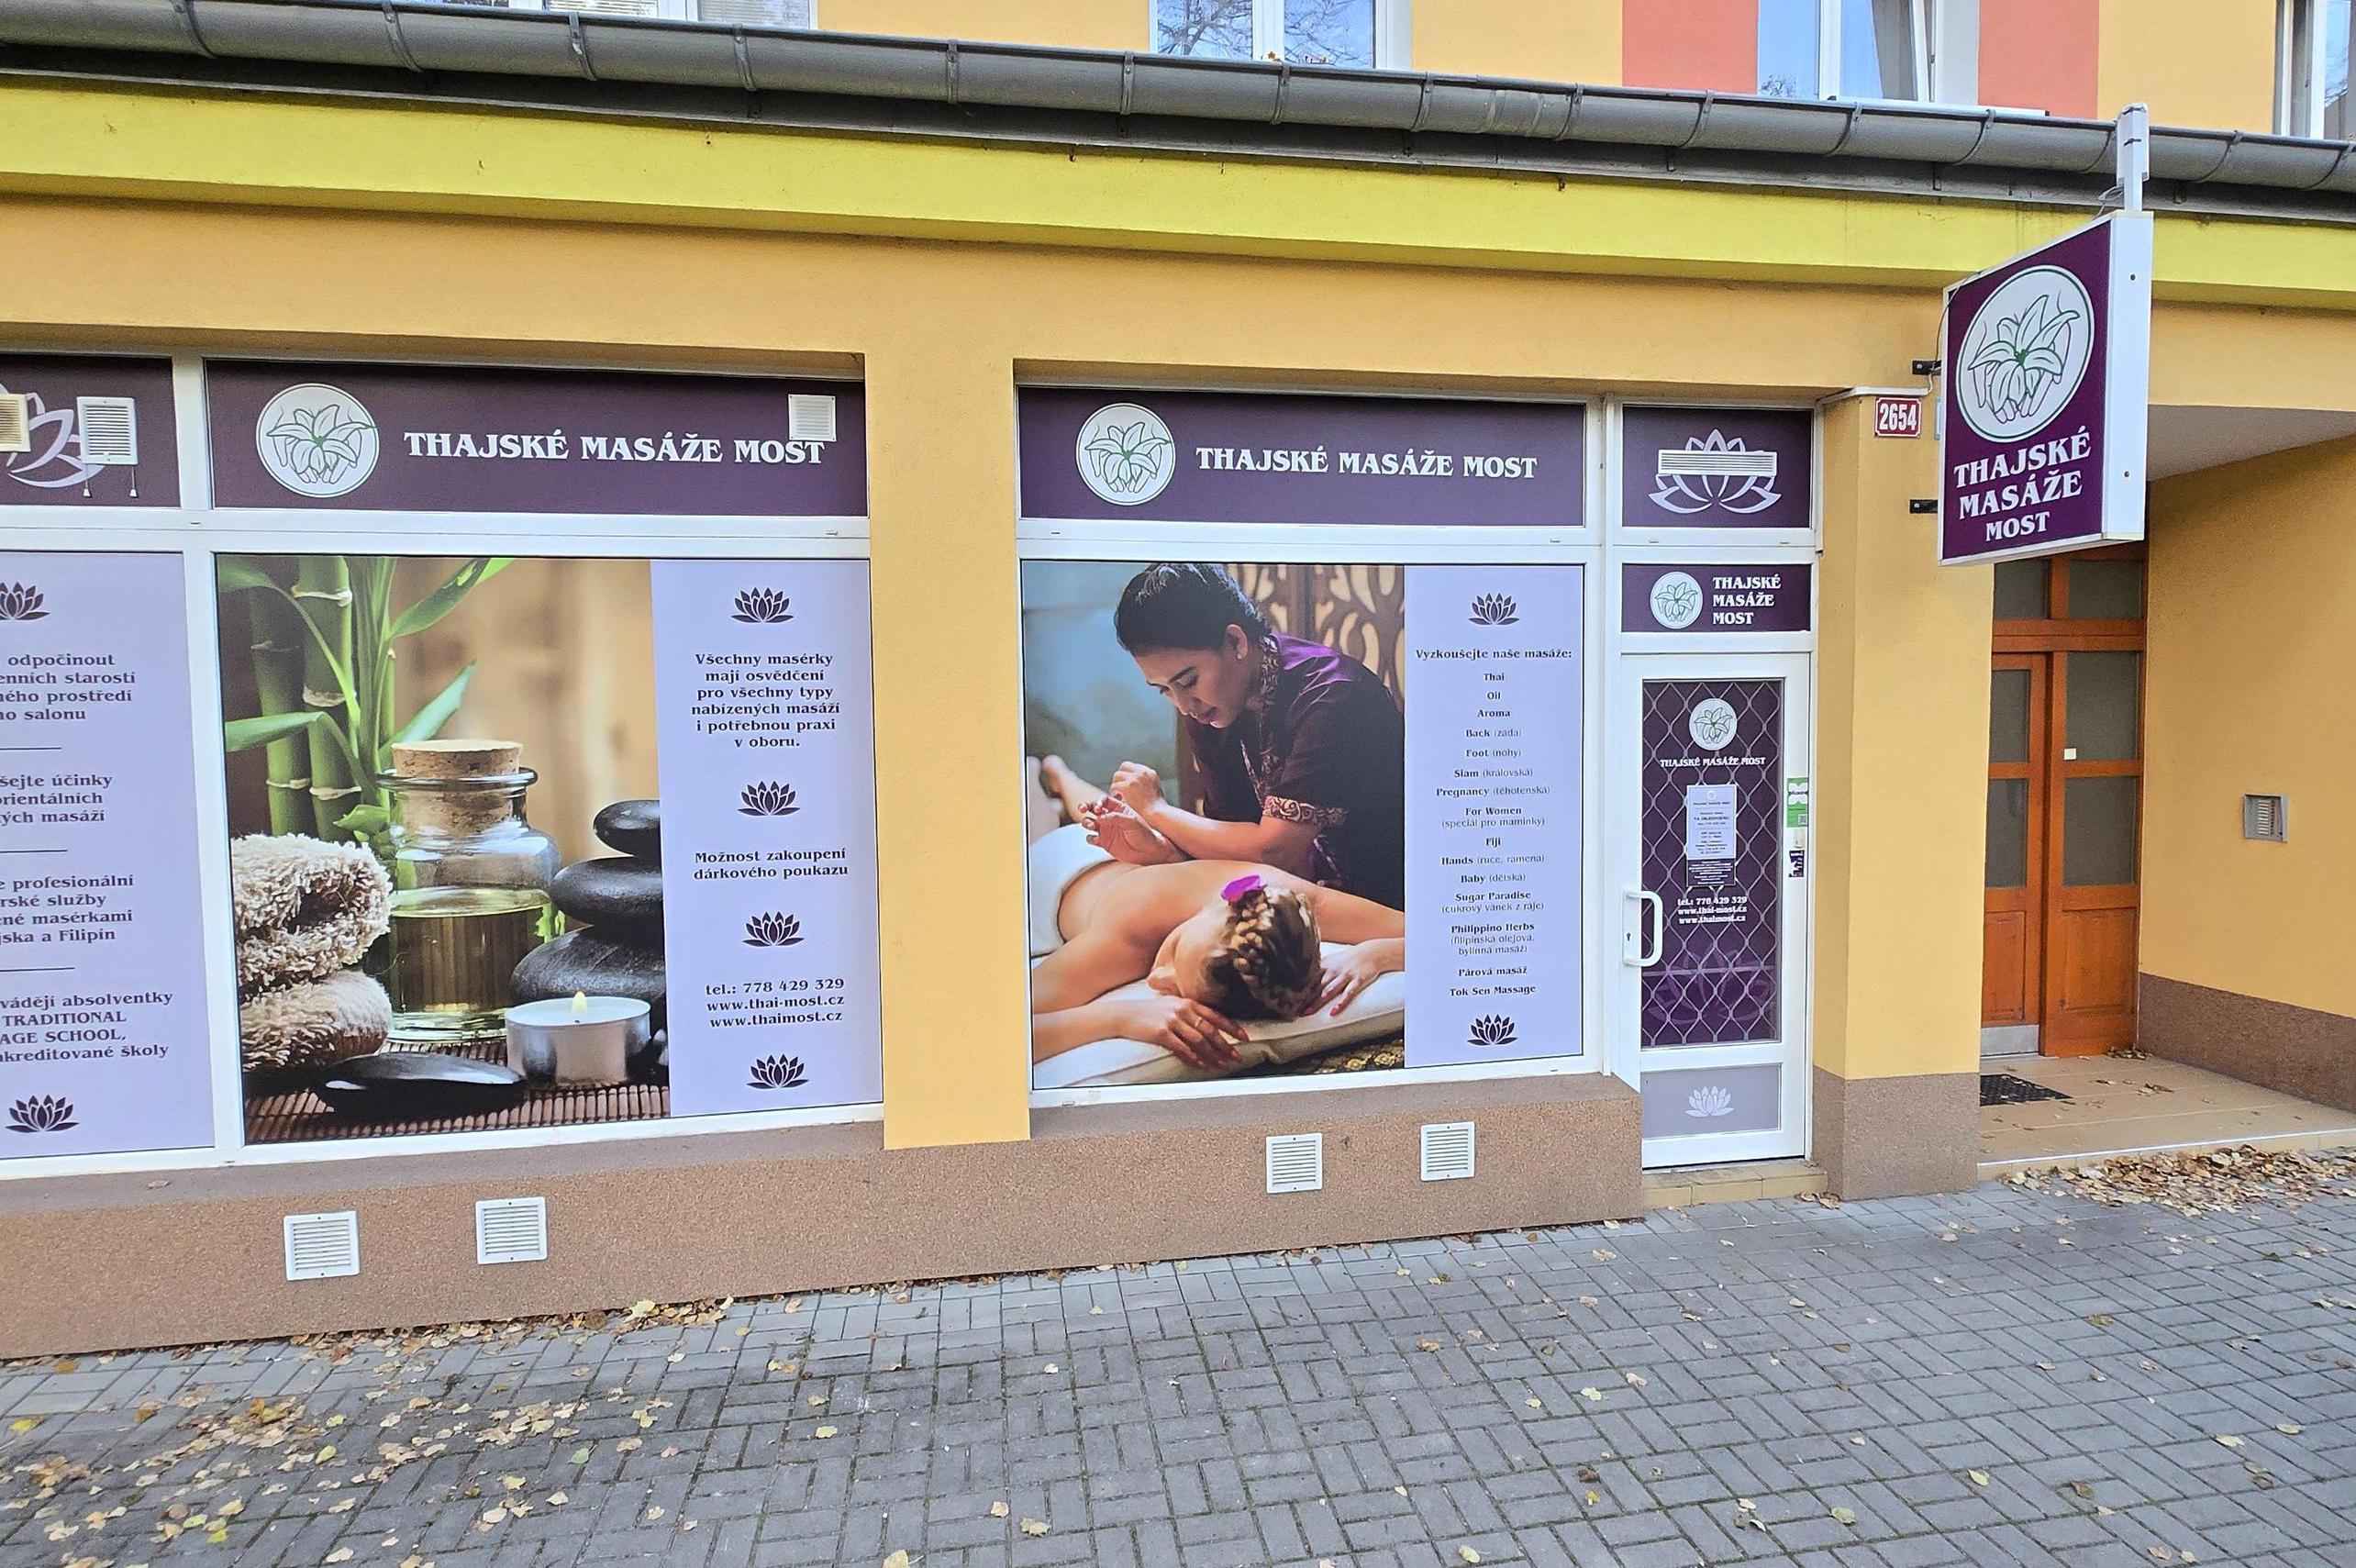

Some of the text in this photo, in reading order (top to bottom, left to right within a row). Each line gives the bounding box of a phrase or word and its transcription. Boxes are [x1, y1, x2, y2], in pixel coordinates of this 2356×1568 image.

[1880, 404, 1917, 430] 2654
[405, 429, 825, 465] THAJSKÉ MASÁŽE MOST
[1196, 445, 1538, 479] THAJSKÉ MASÁŽE MOST
[1953, 426, 2091, 487] THAJSKÉ
[1960, 471, 2082, 519] MASÁŽE
[1986, 511, 2050, 541] MOST
[1713, 573, 1781, 589] THAJSKÉ
[1713, 592, 1774, 606] MASÁŽE
[1713, 612, 1753, 625] MOST
[8, 653, 115, 669] odpočinout
[696, 653, 833, 667] Všechny masérky
[1416, 648, 1573, 661] Vyzkoušejte naše masáže:
[64, 671, 136, 684] starostí
[706, 668, 824, 684] mají osvědčení
[1483, 673, 1505, 681] Thai
[47, 689, 132, 705] prostředí
[697, 685, 833, 701] pro všechny typy
[1487, 692, 1501, 700] Oil
[24, 708, 86, 720] salonu
[692, 702, 839, 717] nabízených masáží
[1477, 709, 1510, 717] Aroma
[696, 718, 836, 733] i potřebnou praxi
[1466, 729, 1490, 738] Back
[735, 736, 800, 749] v oboru.
[1466, 749, 1522, 759] Foot (nohy)
[1660, 756, 1766, 768] THAJSKÉ MASÁŽE MOST
[1453, 769, 1479, 778] Siam
[52, 773, 112, 789] účinky
[1436, 787, 1489, 798] Pregnancy
[0, 809, 105, 826] ých masáží
[1465, 806, 1522, 816] For Women
[1481, 819, 1495, 828] pro
[1485, 838, 1501, 848] Fiji
[695, 848, 845, 862] Možnost zakoupení
[1441, 857, 1473, 865] Hands
[694, 865, 848, 878] dárkového poukazu
[13, 874, 134, 892] profesionální
[1461, 874, 1485, 884] Baby
[47, 894, 106, 908] služby
[1455, 891, 1531, 904] Sugar Paradise
[0, 909, 132, 926] né masérkami
[41, 934, 51, 942] a
[59, 929, 116, 944] Filipín
[1451, 923, 1535, 937] Philippino Herbs
[1458, 965, 1528, 977] Párová masáž
[706, 977, 844, 995] tel.: 778 429 329
[1450, 984, 1536, 997] Tok Sen Massage
[62, 992, 173, 1007] absolventky
[706, 995, 844, 1010] www.thai-most.cz
[3, 1011, 127, 1027] TRADITIONAL
[710, 1012, 842, 1027] www.thaimost.cz
[121, 1044, 169, 1059] školy
